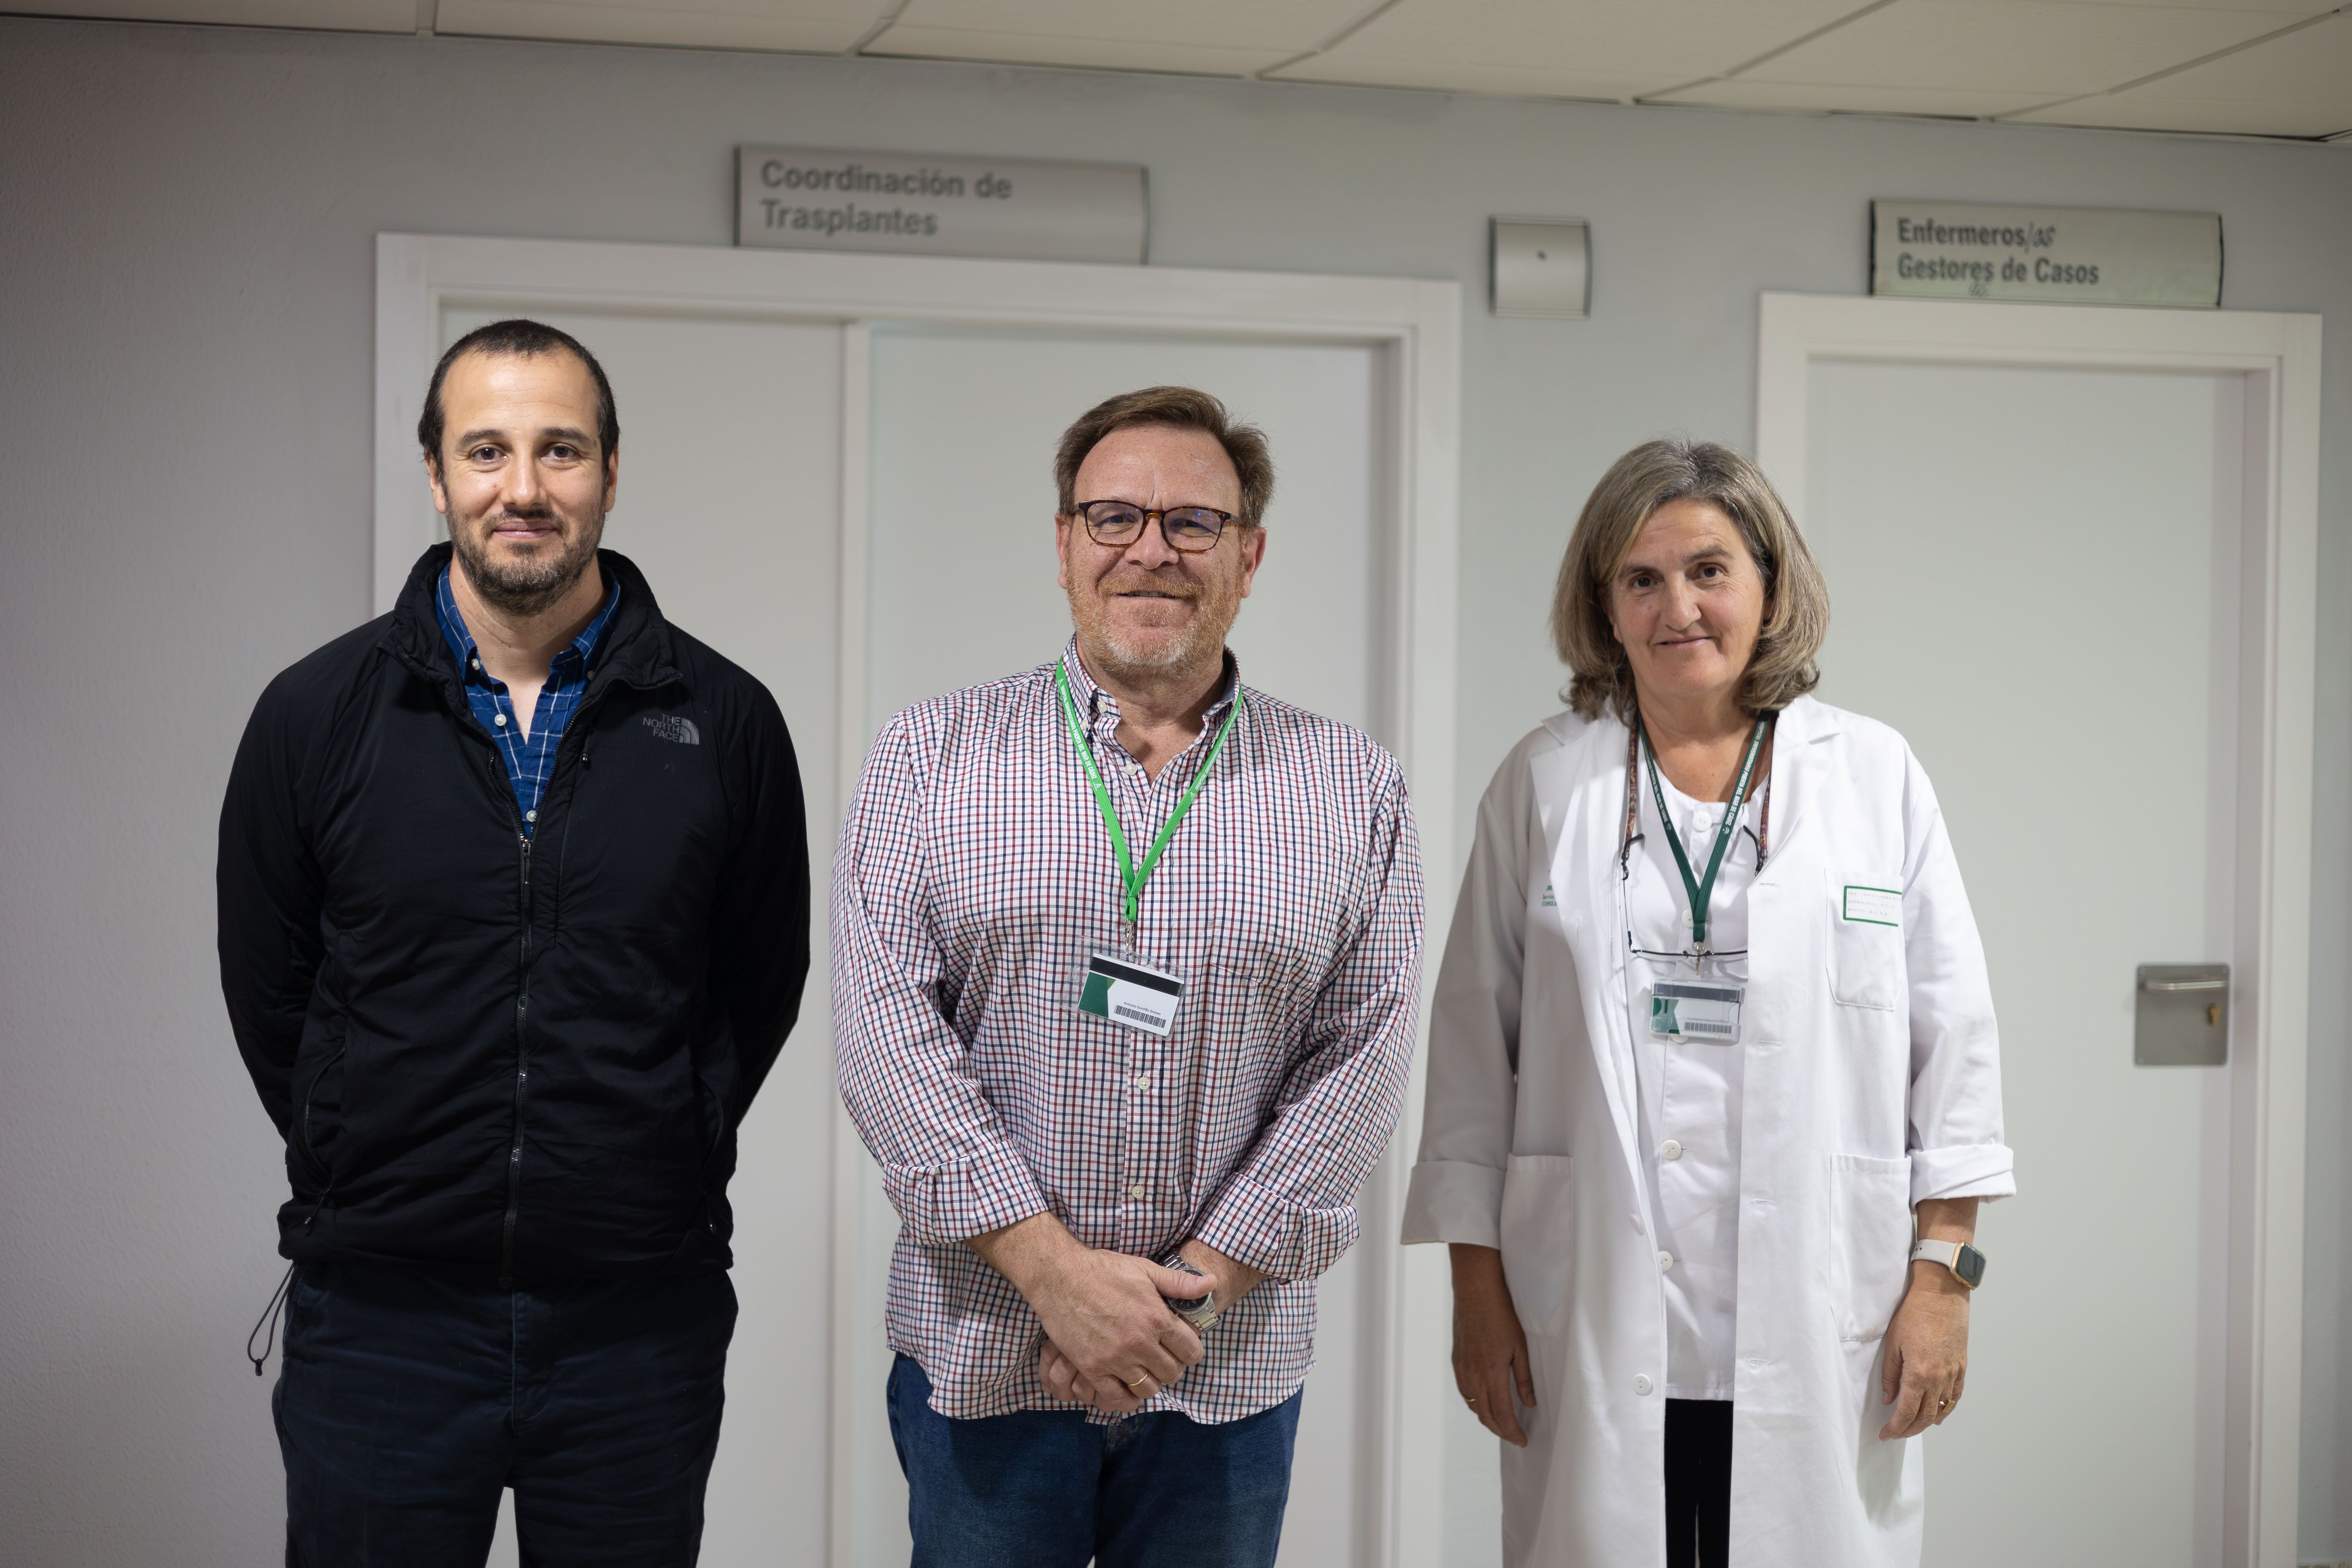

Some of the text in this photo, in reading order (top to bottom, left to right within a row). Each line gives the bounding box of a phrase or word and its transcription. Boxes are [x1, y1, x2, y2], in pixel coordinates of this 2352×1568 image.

[760, 159, 1014, 200] Coordinación de
[760, 199, 939, 237] Trasplantes
[1897, 251, 2100, 285] Gestores de Casos
[643, 717, 680, 734] NORTH
[661, 713, 681, 726] THE
[653, 728, 679, 743] FACE
[1065, 701, 1076, 730] UNIVERSITARIO
[1073, 729, 1081, 746] PUERTA
[1081, 750, 1089, 761] MAR
[1088, 766, 1097, 780] CÁDIZ
[1195, 772, 1207, 790] HOSPITAL
